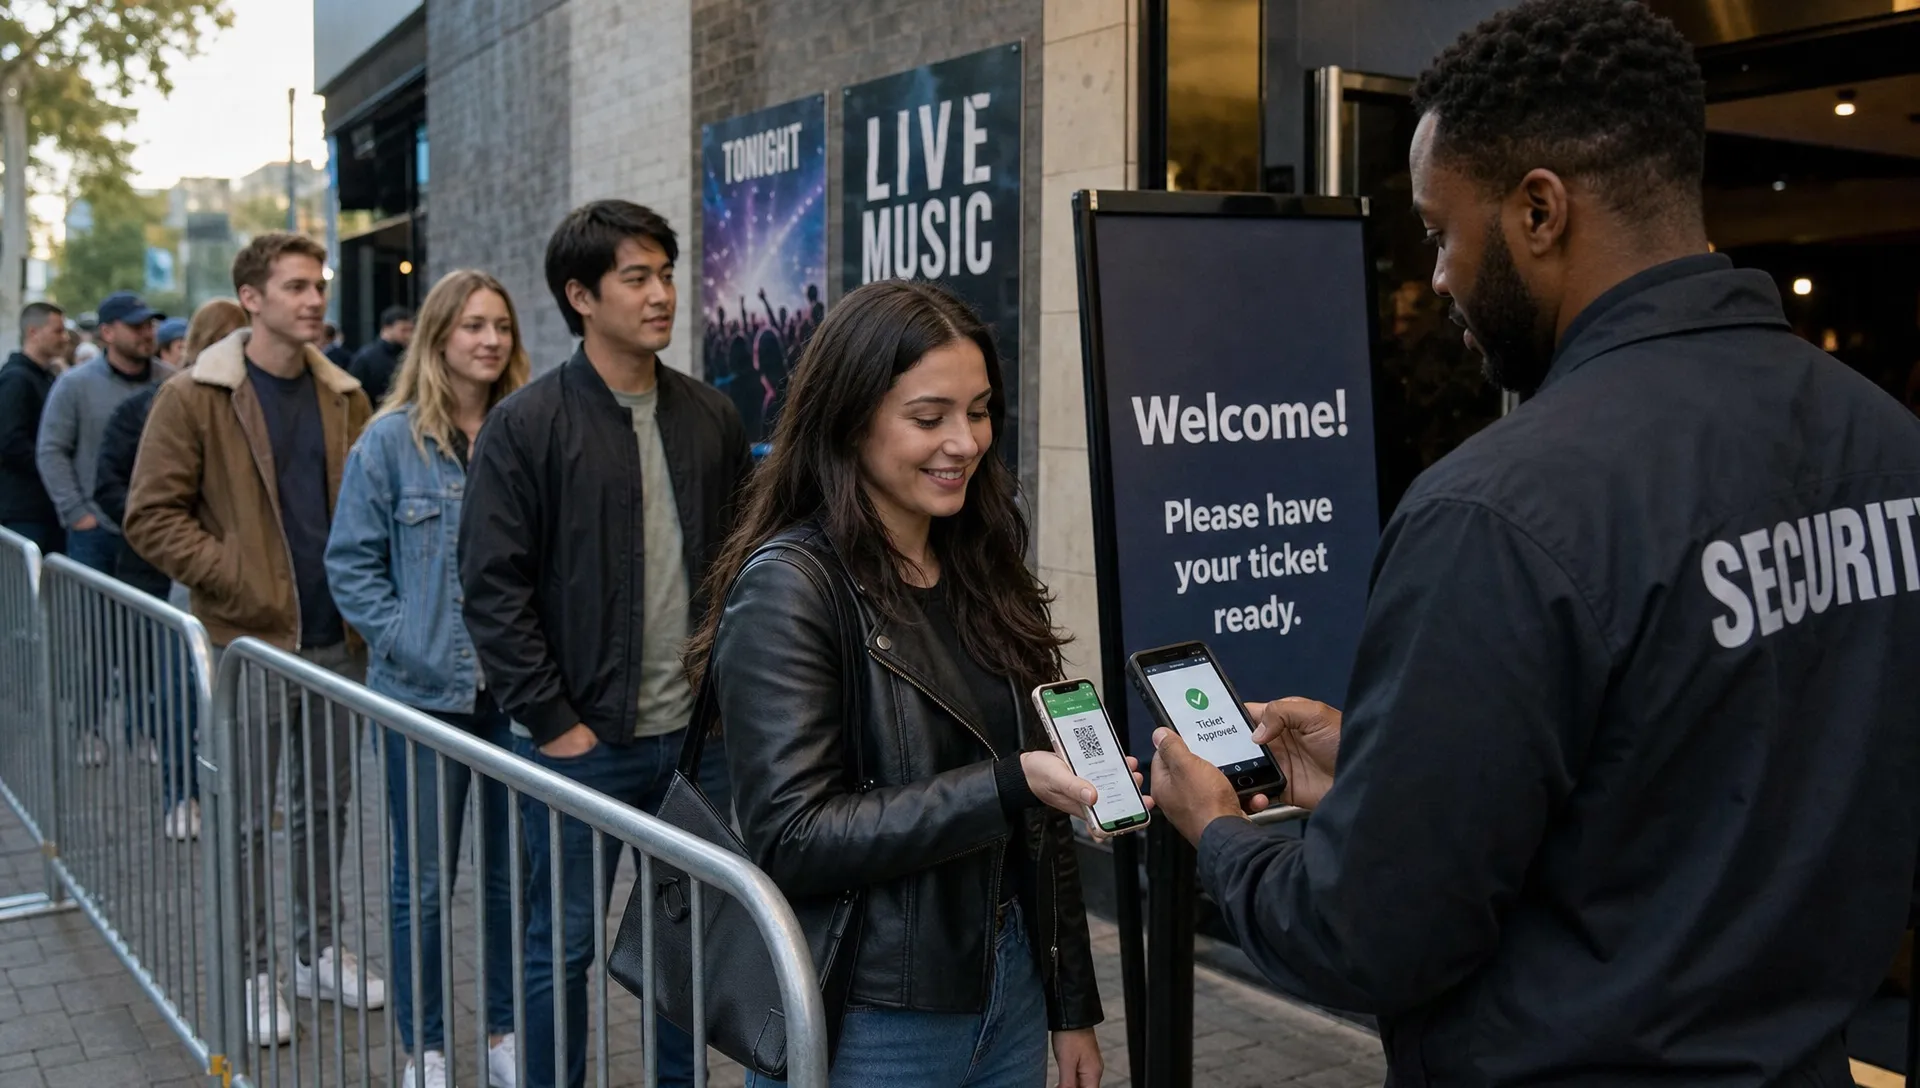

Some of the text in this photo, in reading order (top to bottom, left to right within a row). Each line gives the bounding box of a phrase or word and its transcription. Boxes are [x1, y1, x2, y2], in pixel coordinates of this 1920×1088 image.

[722, 123, 802, 184] TONIGHT
[867, 93, 991, 201] LIVE
[862, 191, 992, 284] MUSIC
[1131, 388, 1349, 446] Welcome!
[1164, 492, 1333, 534] Please have
[1174, 542, 1329, 594] your ticket
[1701, 497, 1920, 649] SECURIT
[1214, 594, 1302, 635] ready.
[1196, 716, 1225, 729] Ticket
[1197, 725, 1238, 742] Approved
